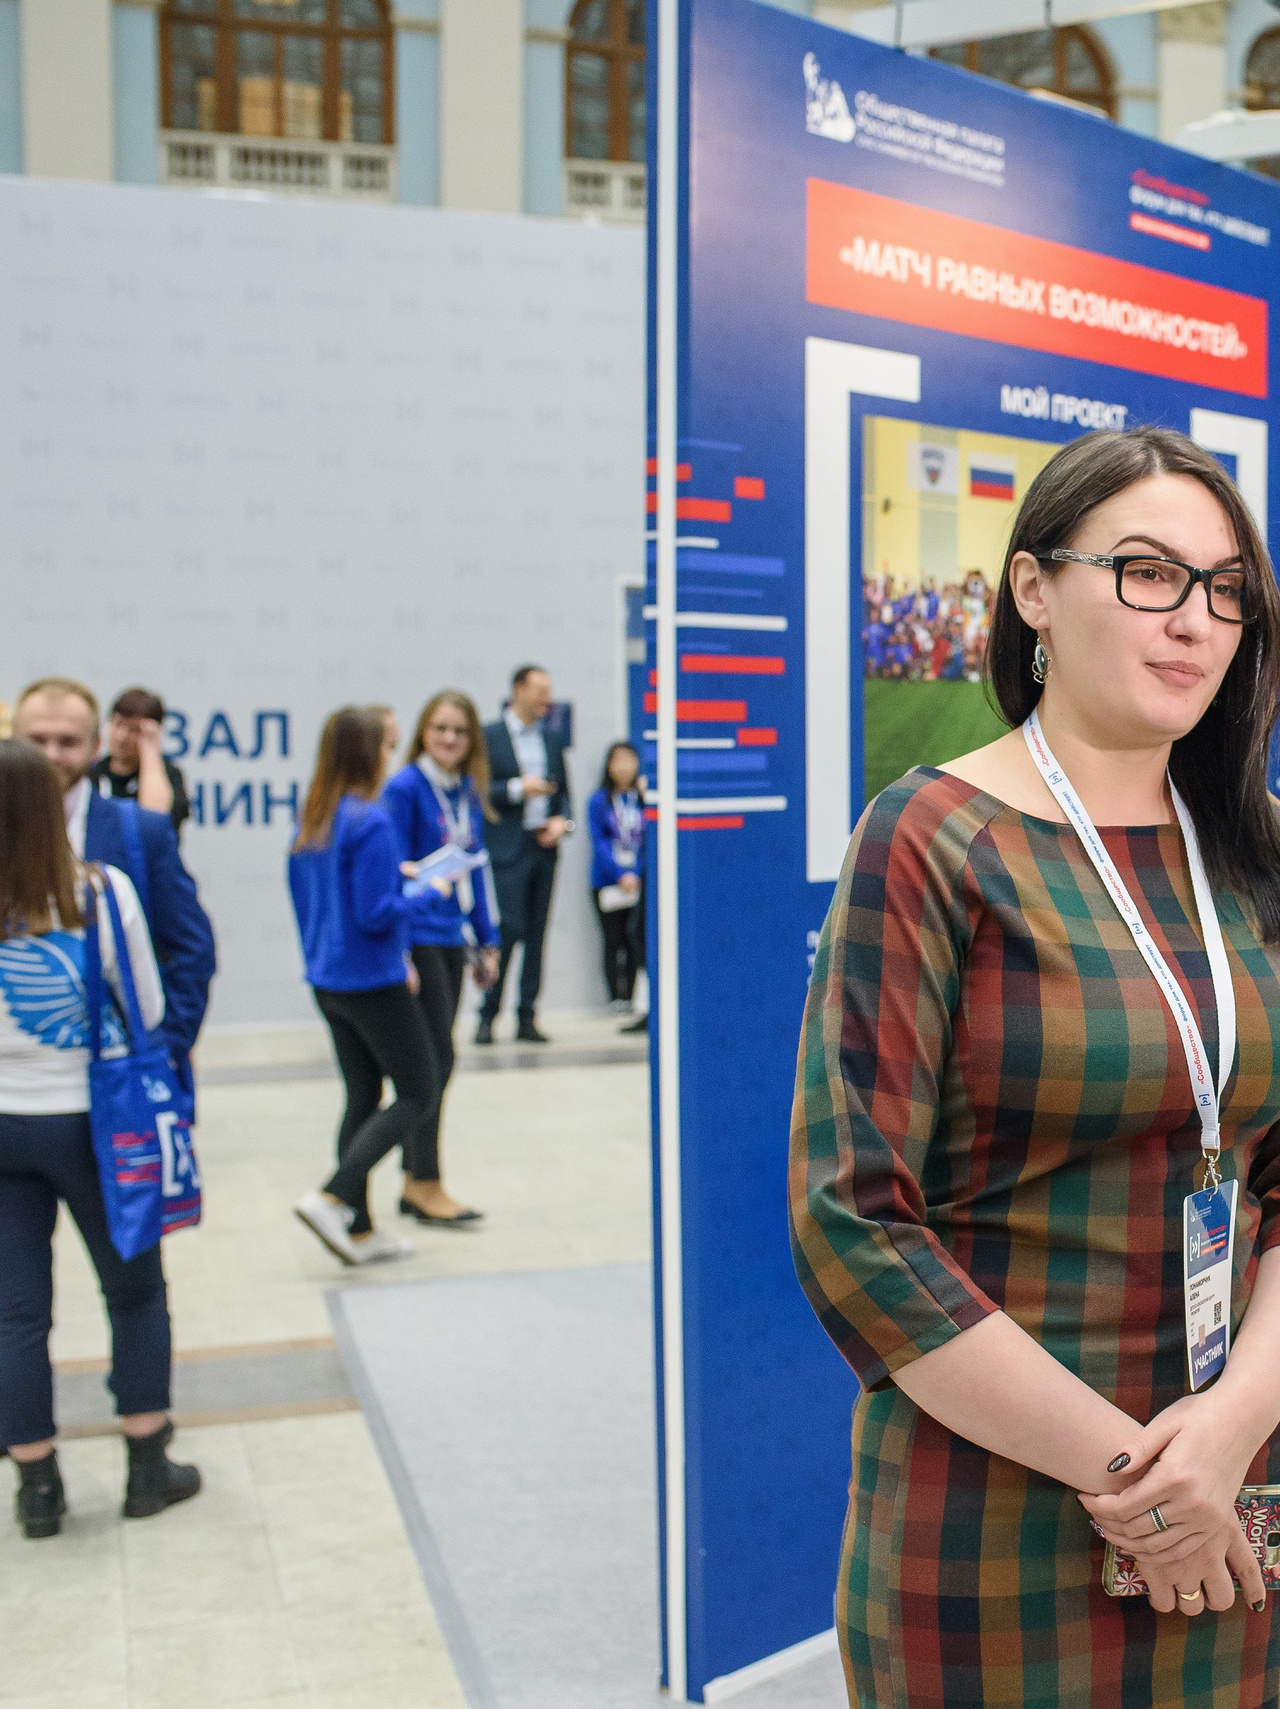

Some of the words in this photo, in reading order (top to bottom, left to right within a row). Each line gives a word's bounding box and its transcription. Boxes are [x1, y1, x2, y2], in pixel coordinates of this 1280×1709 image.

[840, 235, 931, 288] «МАТЧ
[936, 257, 1047, 314] РАВНЫХ
[1047, 285, 1248, 360] ВОЗМОЖНОСТЕЙ»
[1000, 385, 1050, 421] МОЙ
[1051, 394, 1129, 430] ПРОЕКТ
[1104, 866, 1133, 916] «Сообщество»
[1187, 1025, 1205, 1085] «Сообщество»
[1194, 1341, 1224, 1374] УЧАСТНИК
